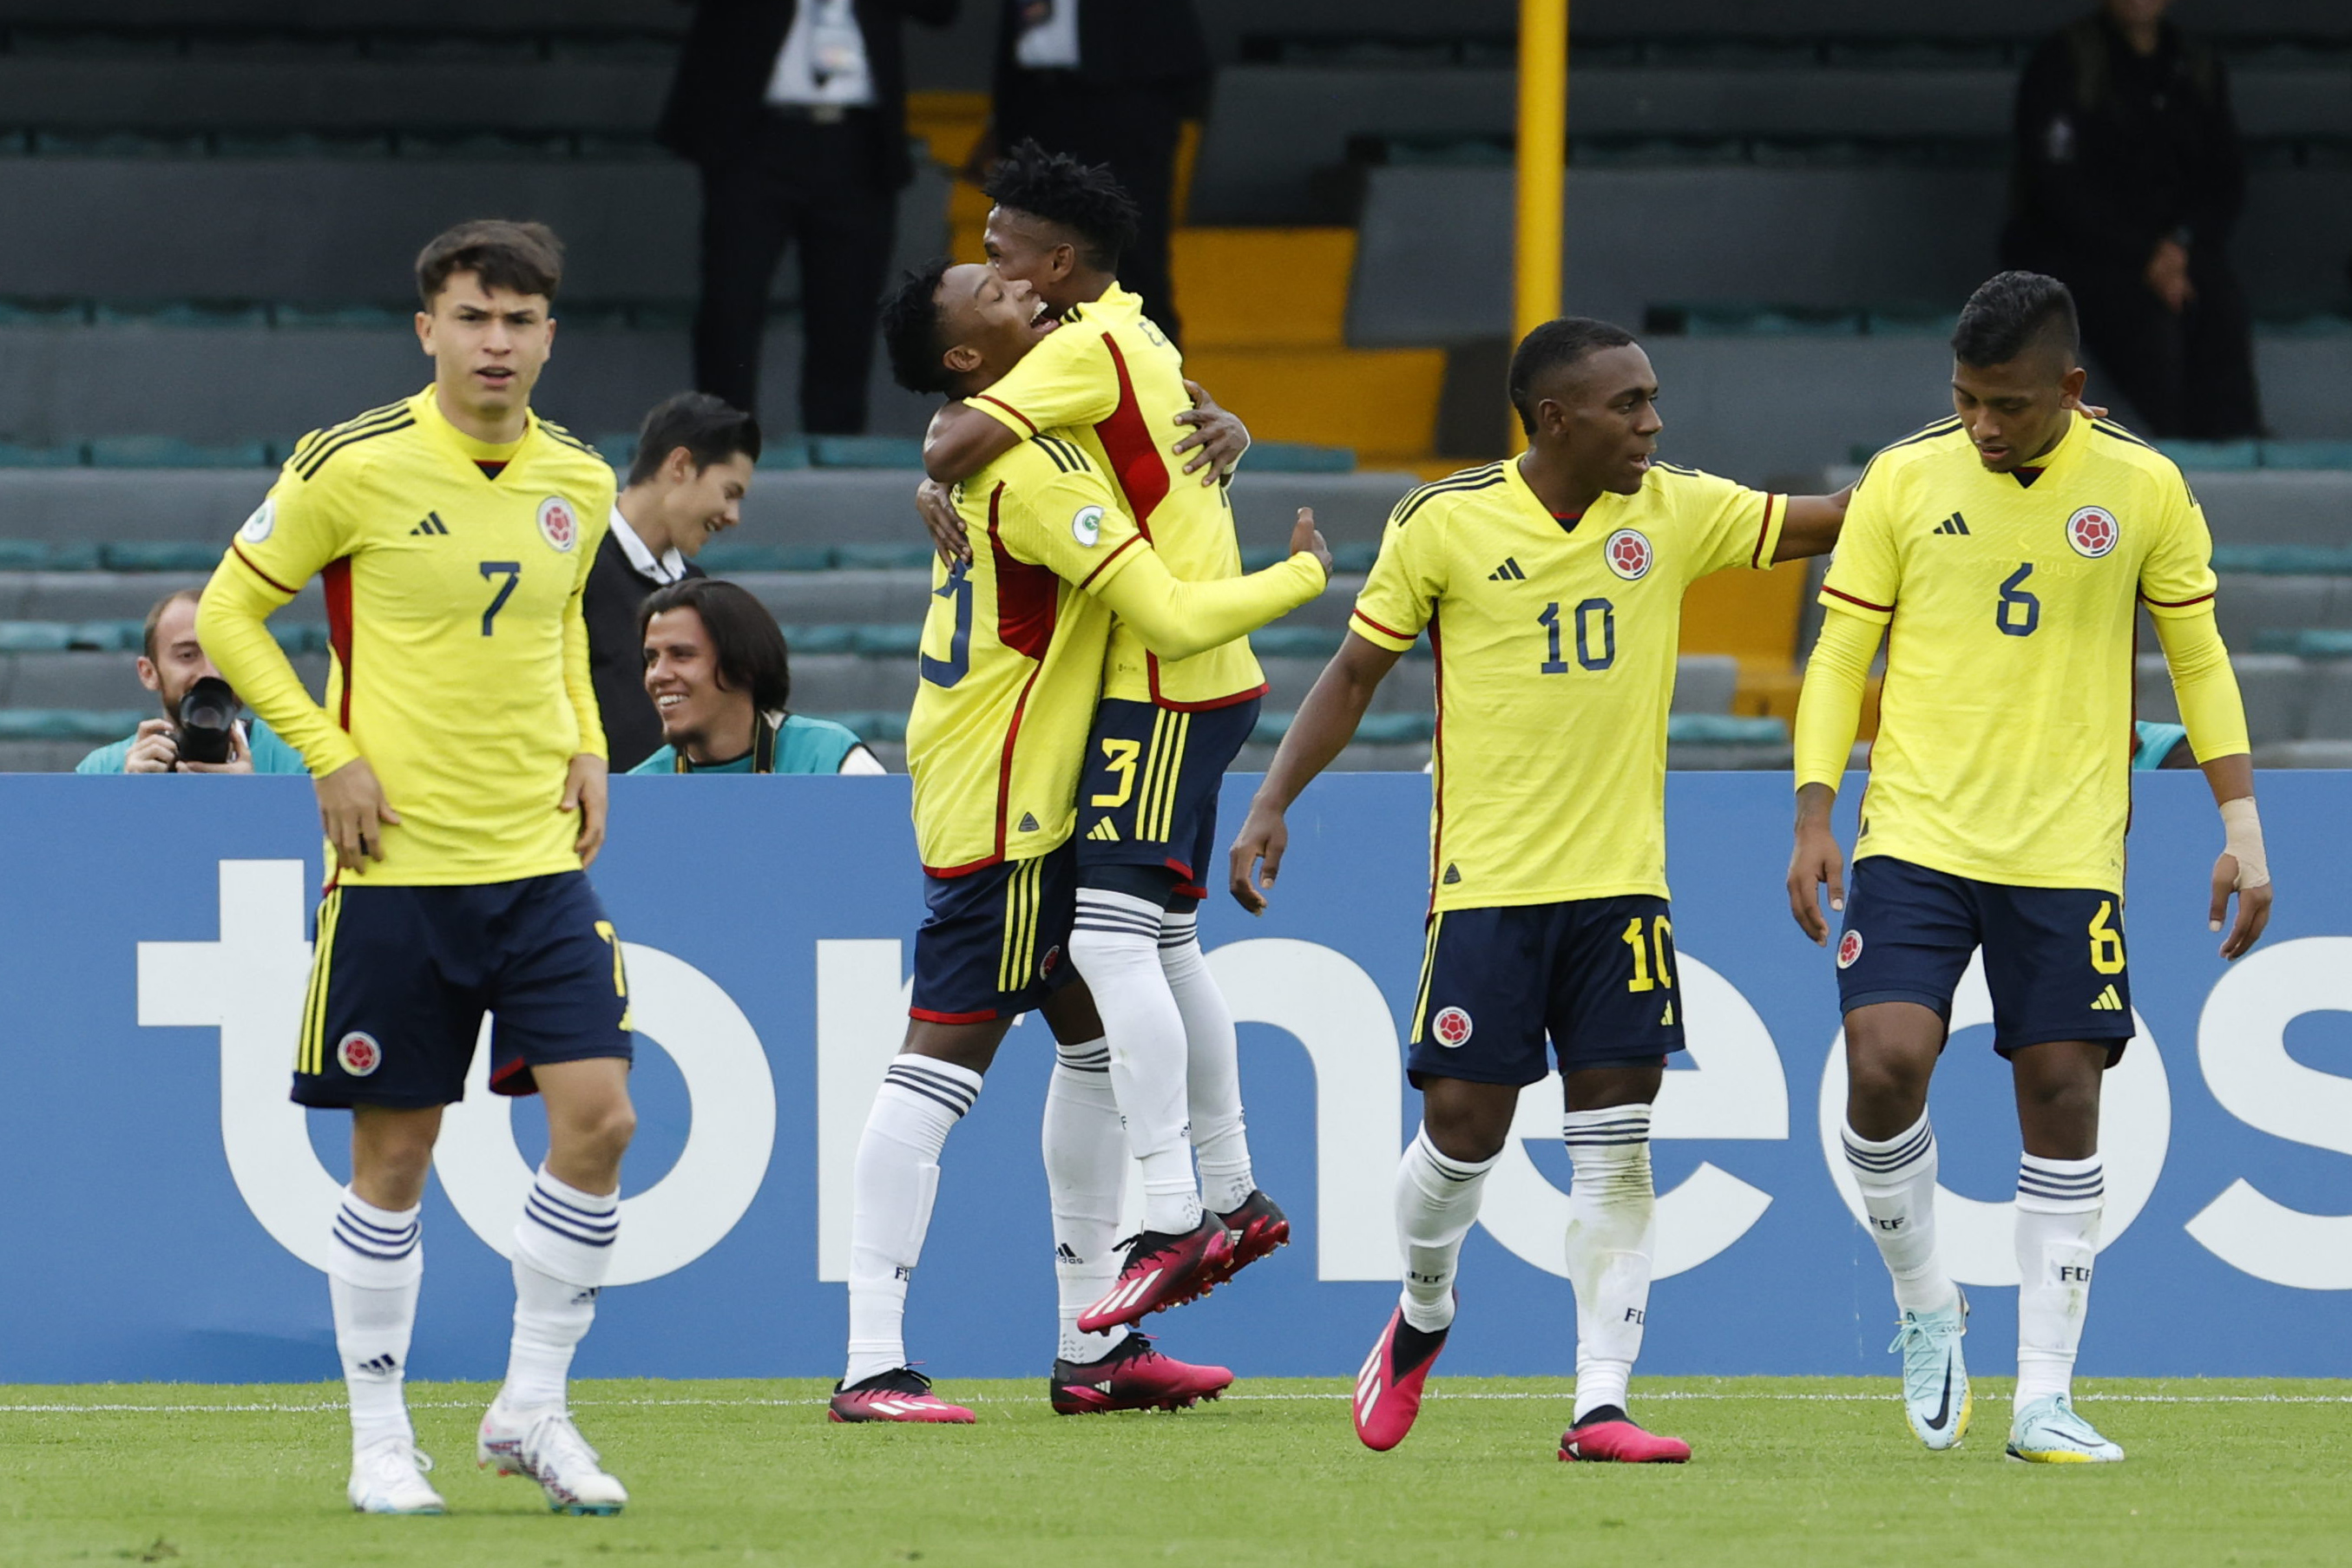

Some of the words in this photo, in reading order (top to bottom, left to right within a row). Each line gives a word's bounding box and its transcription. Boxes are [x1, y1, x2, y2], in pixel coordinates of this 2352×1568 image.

[480, 561, 521, 636] 7
[1537, 597, 1615, 674] 10
[1996, 562, 2040, 636] 6
[1091, 738, 1140, 808] 3
[594, 920, 627, 997] 7
[2088, 901, 2125, 974] 6
